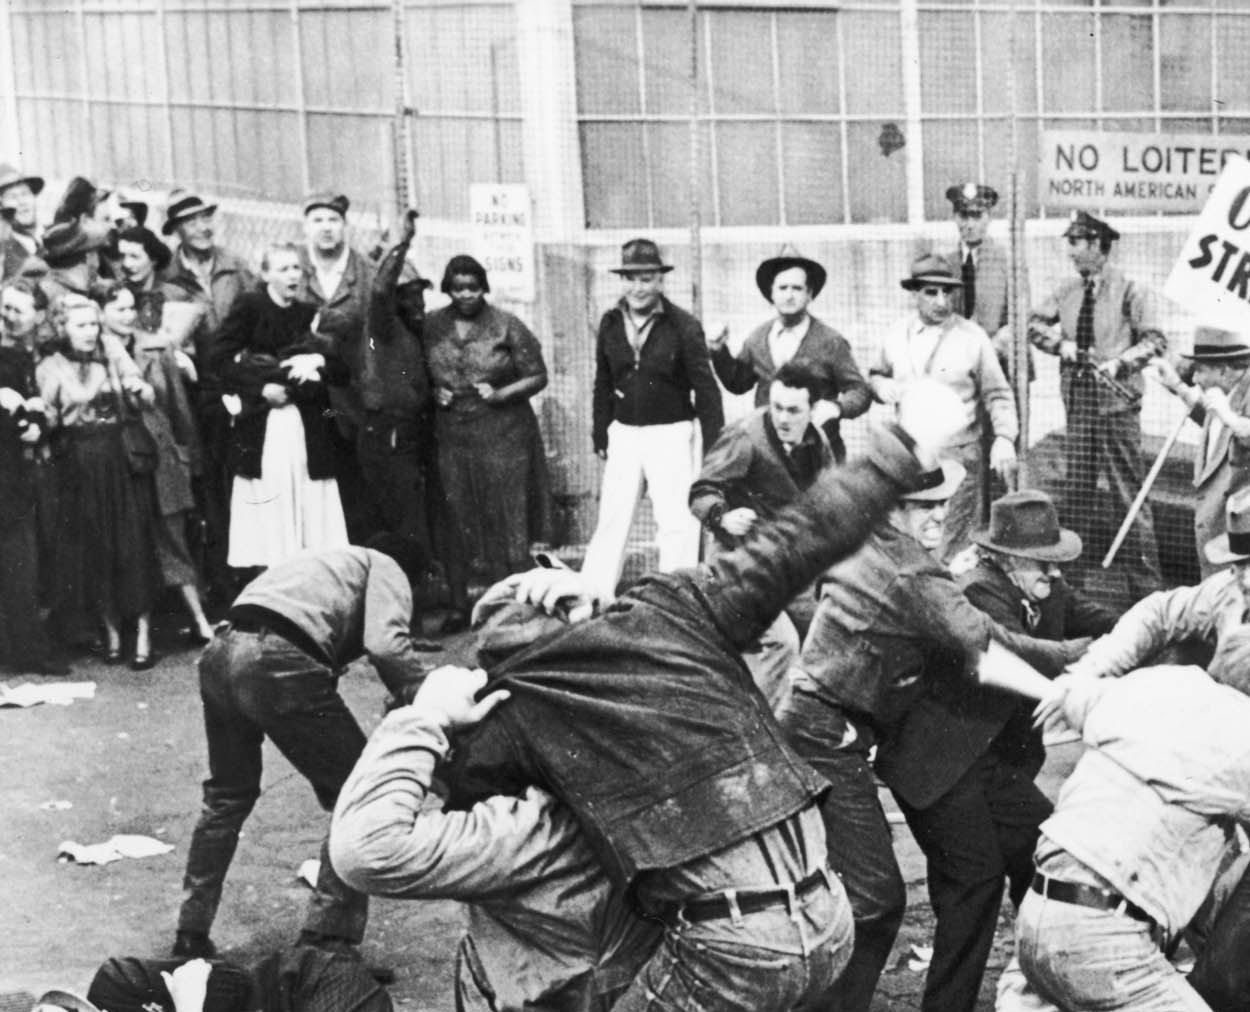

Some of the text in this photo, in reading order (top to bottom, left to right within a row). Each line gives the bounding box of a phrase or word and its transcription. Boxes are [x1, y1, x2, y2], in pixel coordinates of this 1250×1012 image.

[1056, 143, 1099, 171] NO
[1048, 180, 1105, 197] NORTH
[1113, 181, 1197, 199] AMERICAN
